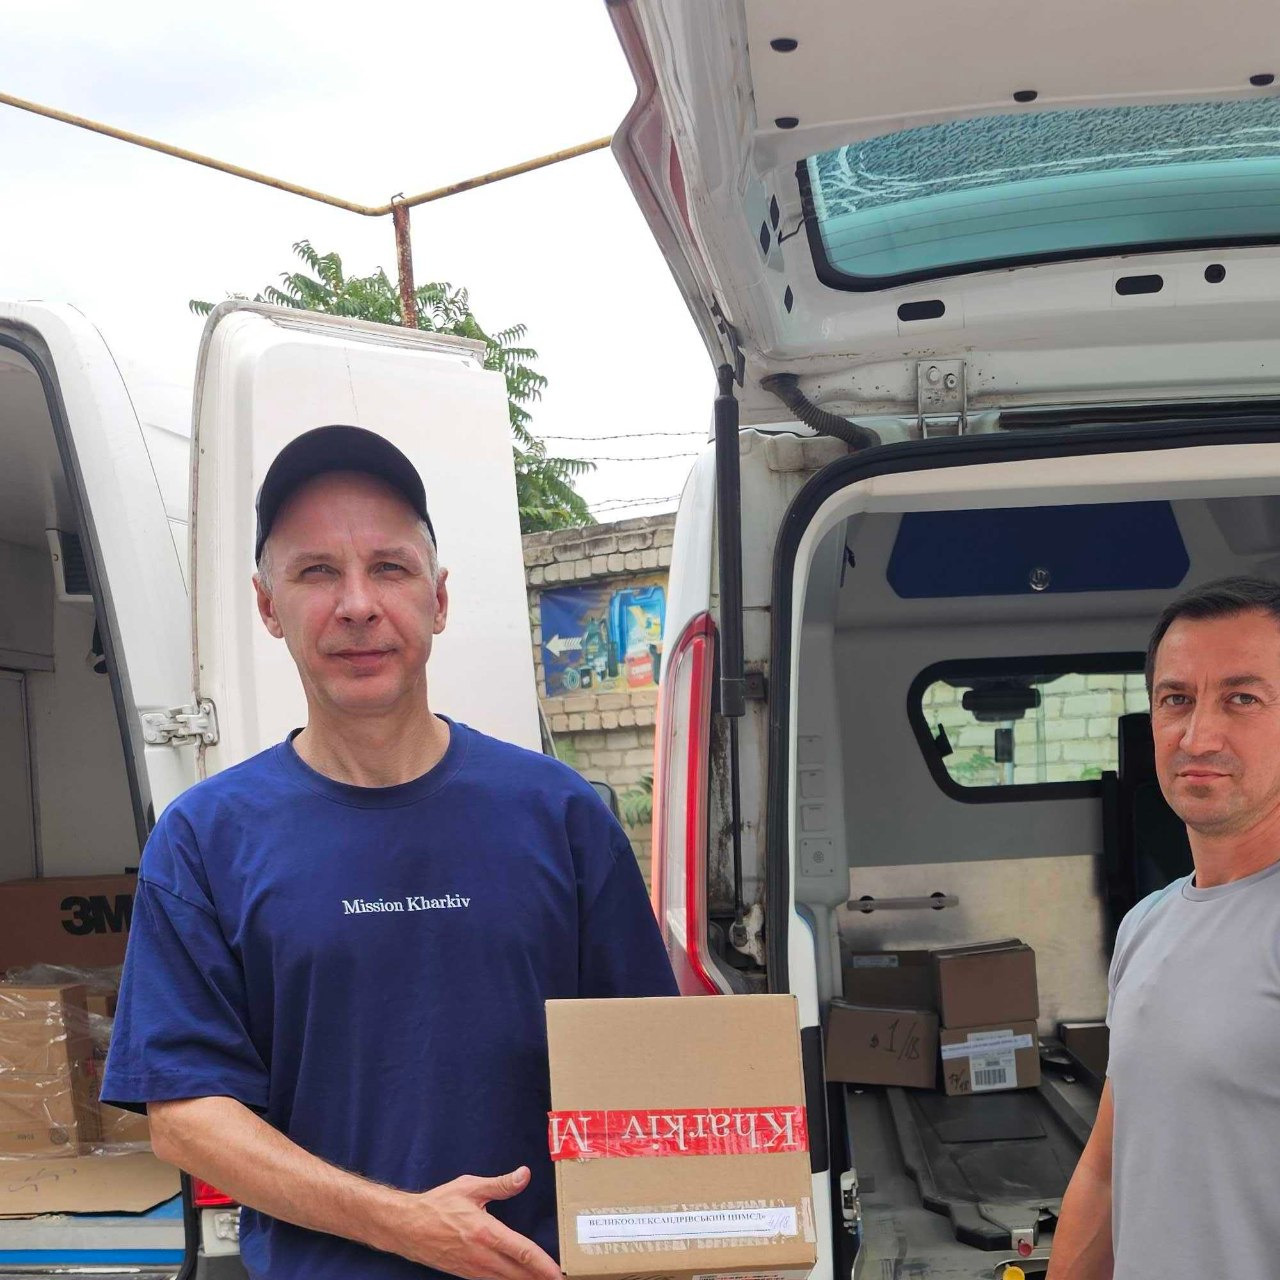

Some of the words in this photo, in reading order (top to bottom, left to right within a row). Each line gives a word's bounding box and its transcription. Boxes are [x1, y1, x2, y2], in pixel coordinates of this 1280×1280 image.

[61, 894, 134, 935] 3M
[342, 898, 404, 914] Mission
[406, 894, 470, 911] Kharkiv
[622, 1111, 798, 1151] Kharkiv
